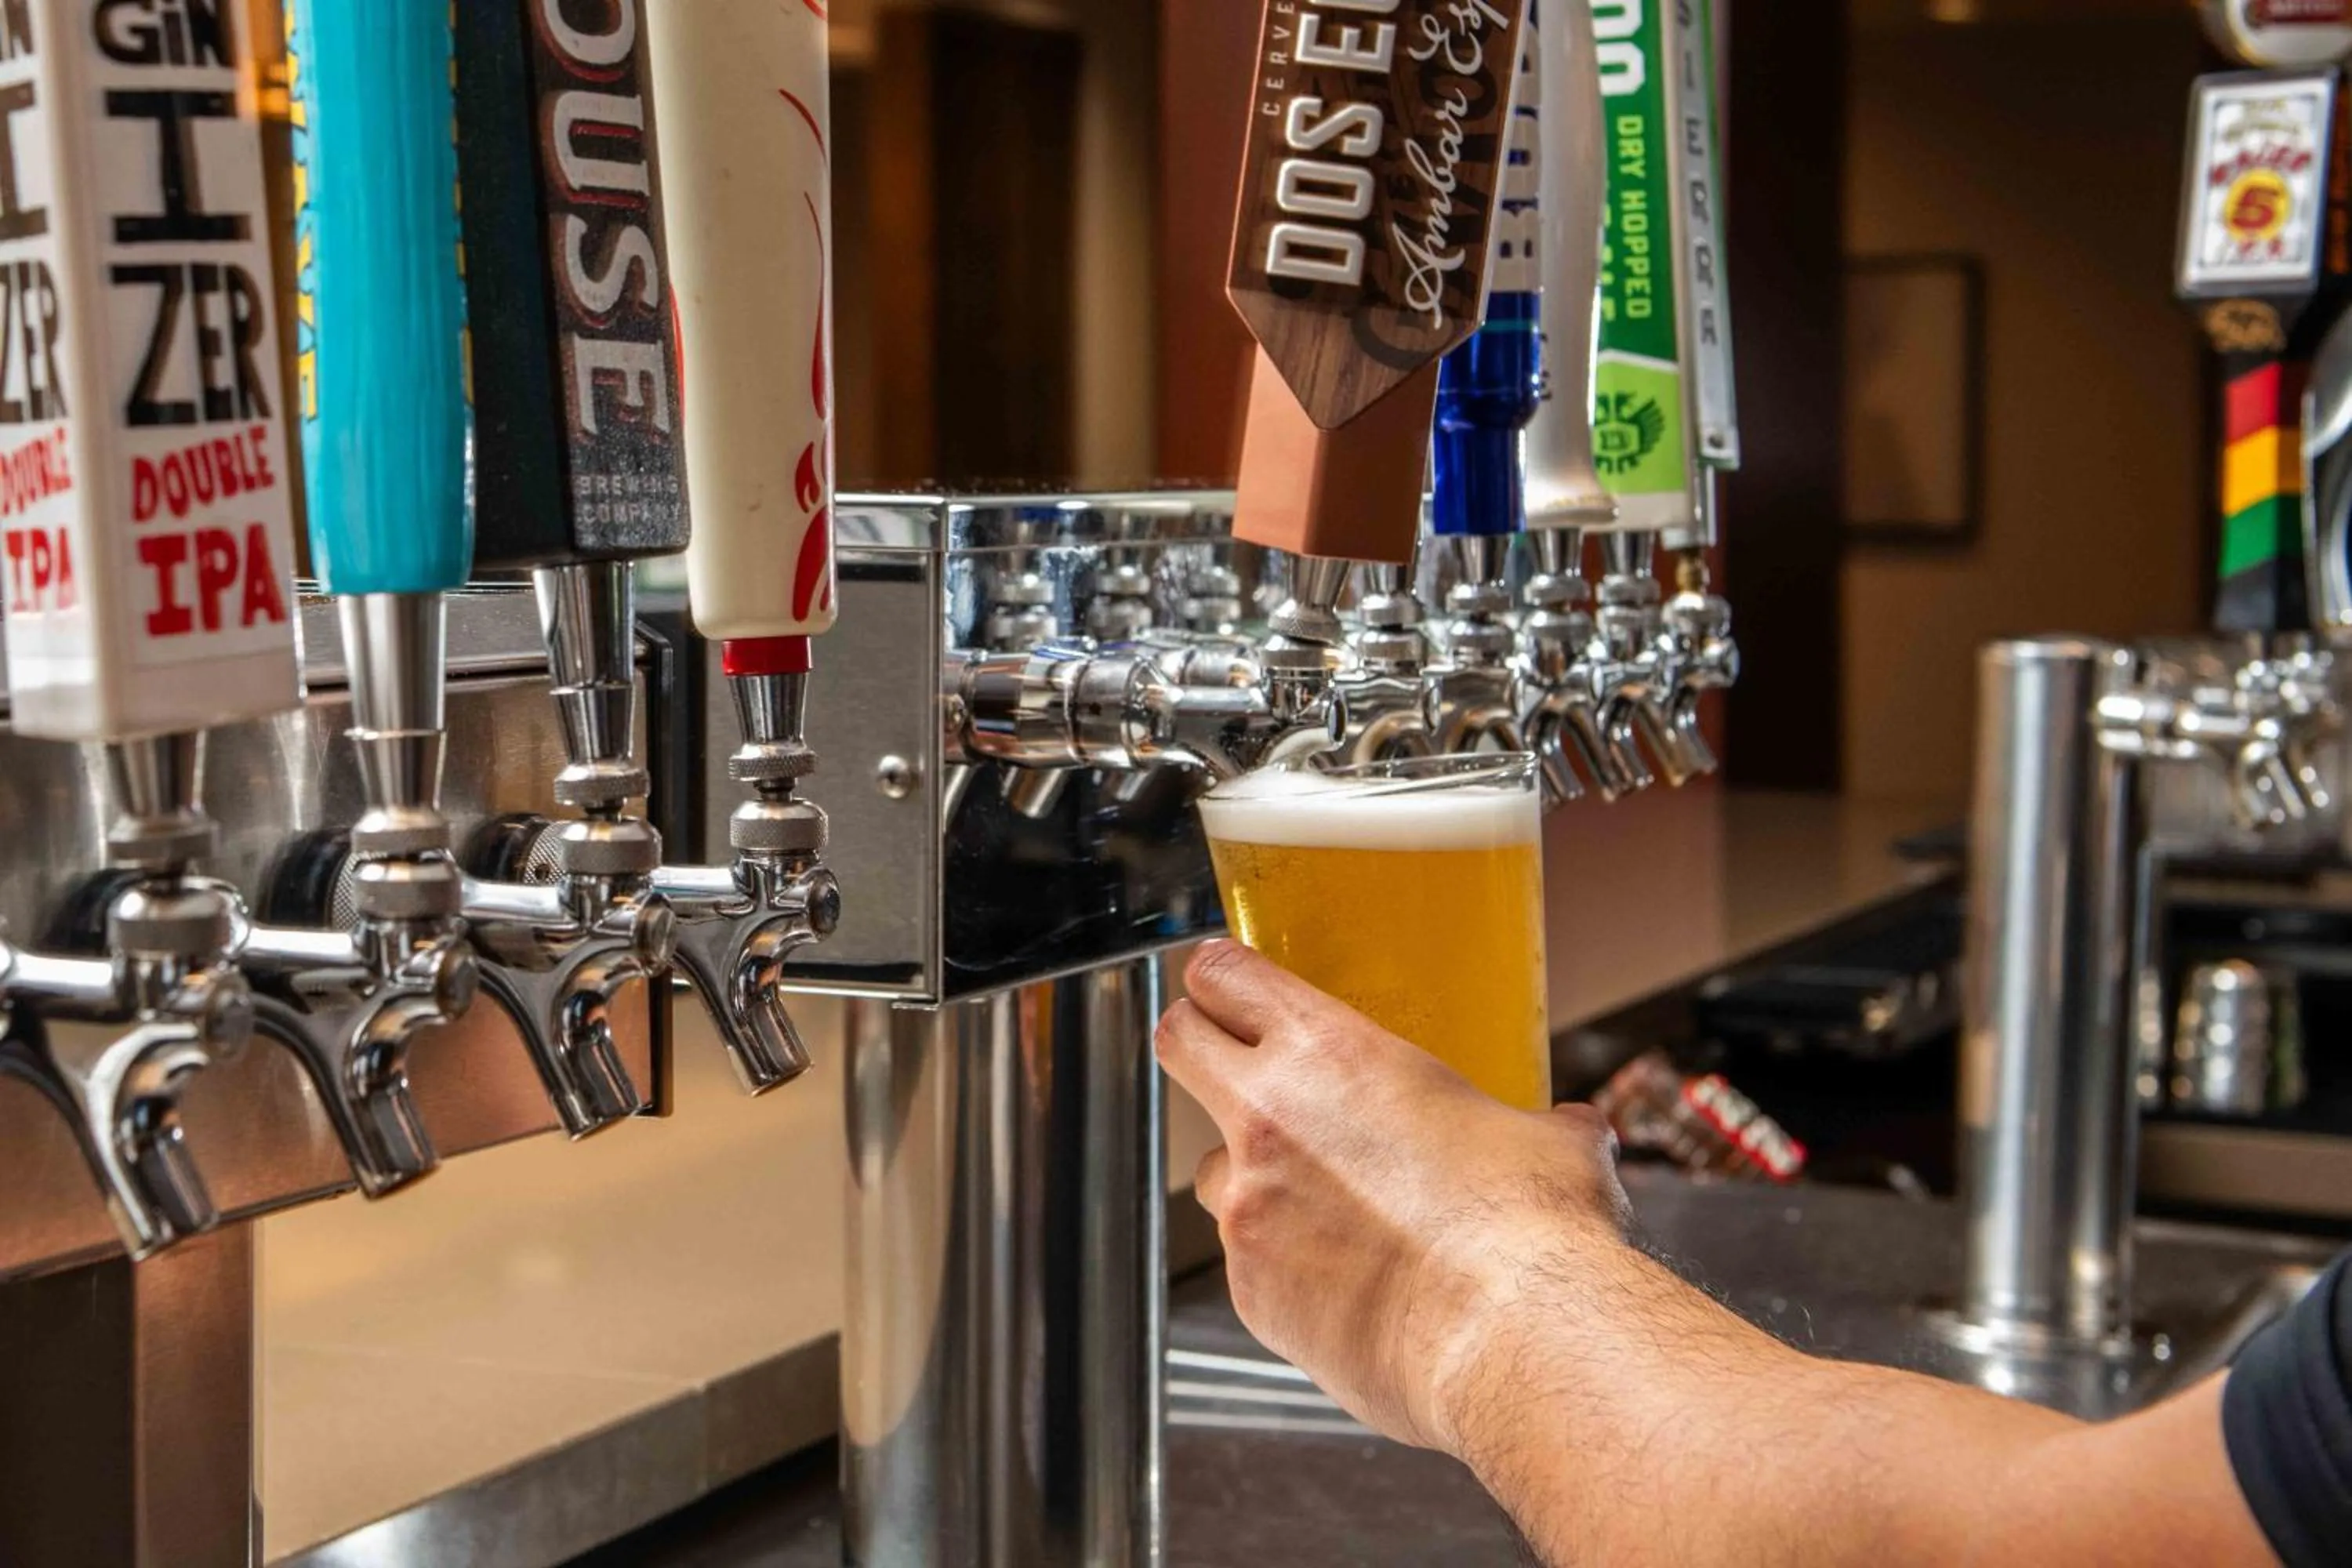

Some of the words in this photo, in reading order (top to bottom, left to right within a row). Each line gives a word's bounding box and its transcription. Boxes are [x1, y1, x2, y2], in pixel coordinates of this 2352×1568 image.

[1294, 0, 1404, 74] E
[104, 89, 252, 243] I
[1265, 96, 1384, 287] DOS
[1617, 114, 1646, 179] DRY
[1392, 88, 1469, 330] Ambar
[1621, 190, 1652, 318] HOPPED
[2231, 185, 2282, 229] 5
[110, 262, 273, 427] ZER
[132, 425, 274, 524] DOUBLE
[5, 526, 76, 612] IPA
[138, 524, 288, 637] IPA
